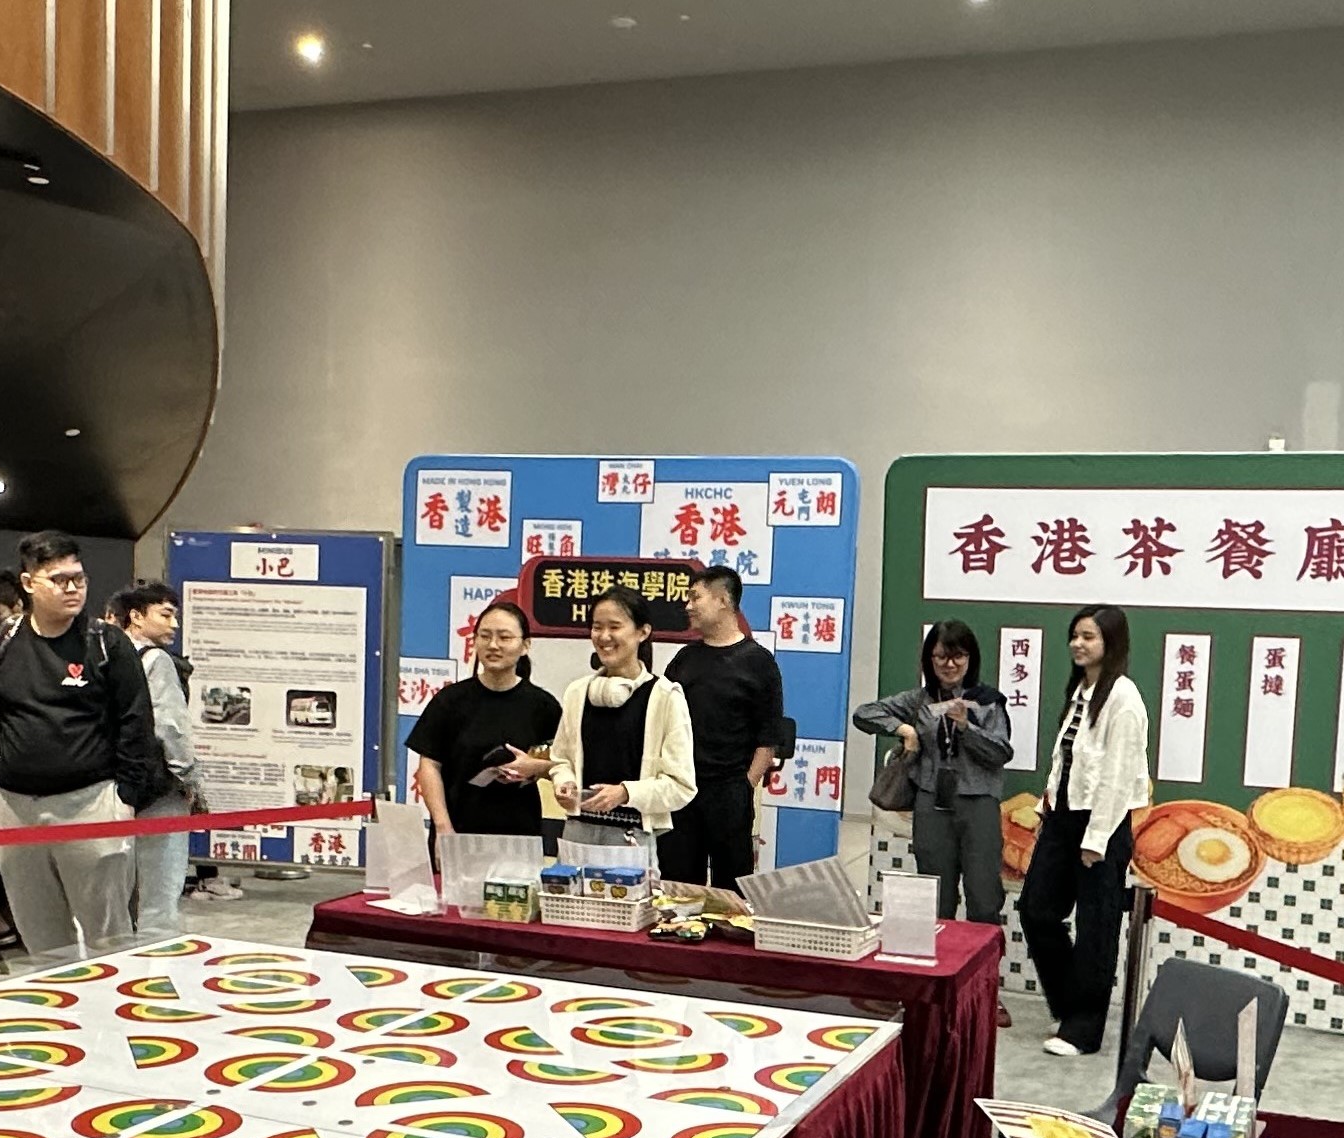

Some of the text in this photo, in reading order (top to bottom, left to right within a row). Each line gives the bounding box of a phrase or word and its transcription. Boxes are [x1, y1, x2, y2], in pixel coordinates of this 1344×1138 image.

[684, 487, 733, 500] HKCHC
[778, 477, 832, 486] YUEN LONG
[455, 489, 473, 537] 製造
[670, 502, 747, 546] 香港
[256, 557, 294, 577] 小巴
[781, 601, 835, 610] KWUN TONG
[1008, 637, 1030, 707] 西多士
[1172, 644, 1197, 719] 餐蛋麵
[1261, 647, 1286, 697] 蛋撻
[309, 832, 346, 854] 香港
